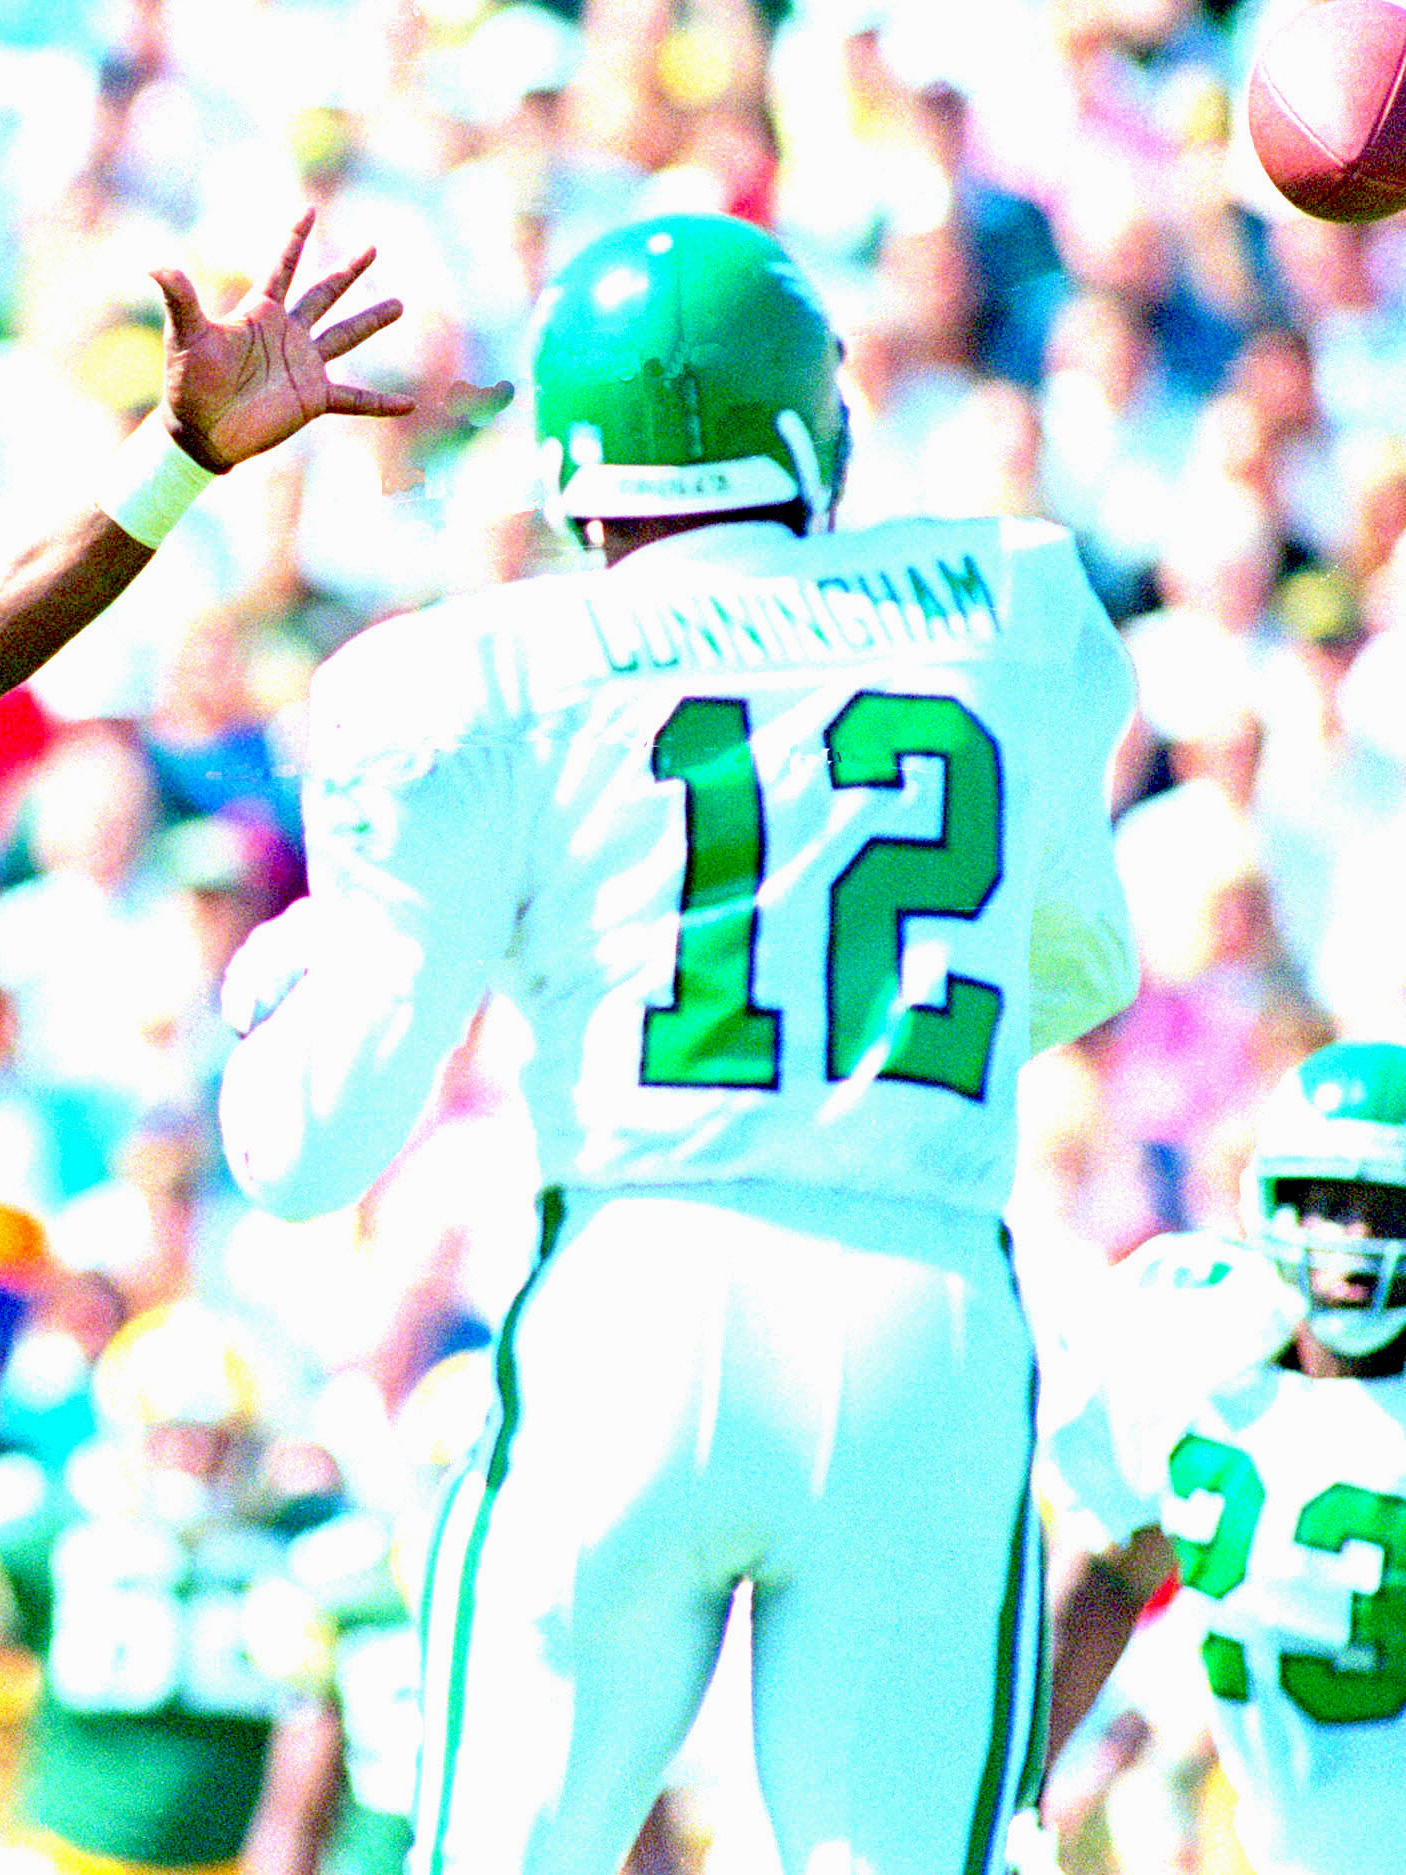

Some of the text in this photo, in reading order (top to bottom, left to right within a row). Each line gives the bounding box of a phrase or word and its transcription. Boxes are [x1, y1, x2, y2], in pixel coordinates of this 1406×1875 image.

[584, 554, 1002, 672] CUNNINGHAM
[638, 689, 1006, 1105] 12
[1167, 1432, 1406, 1726] 23
